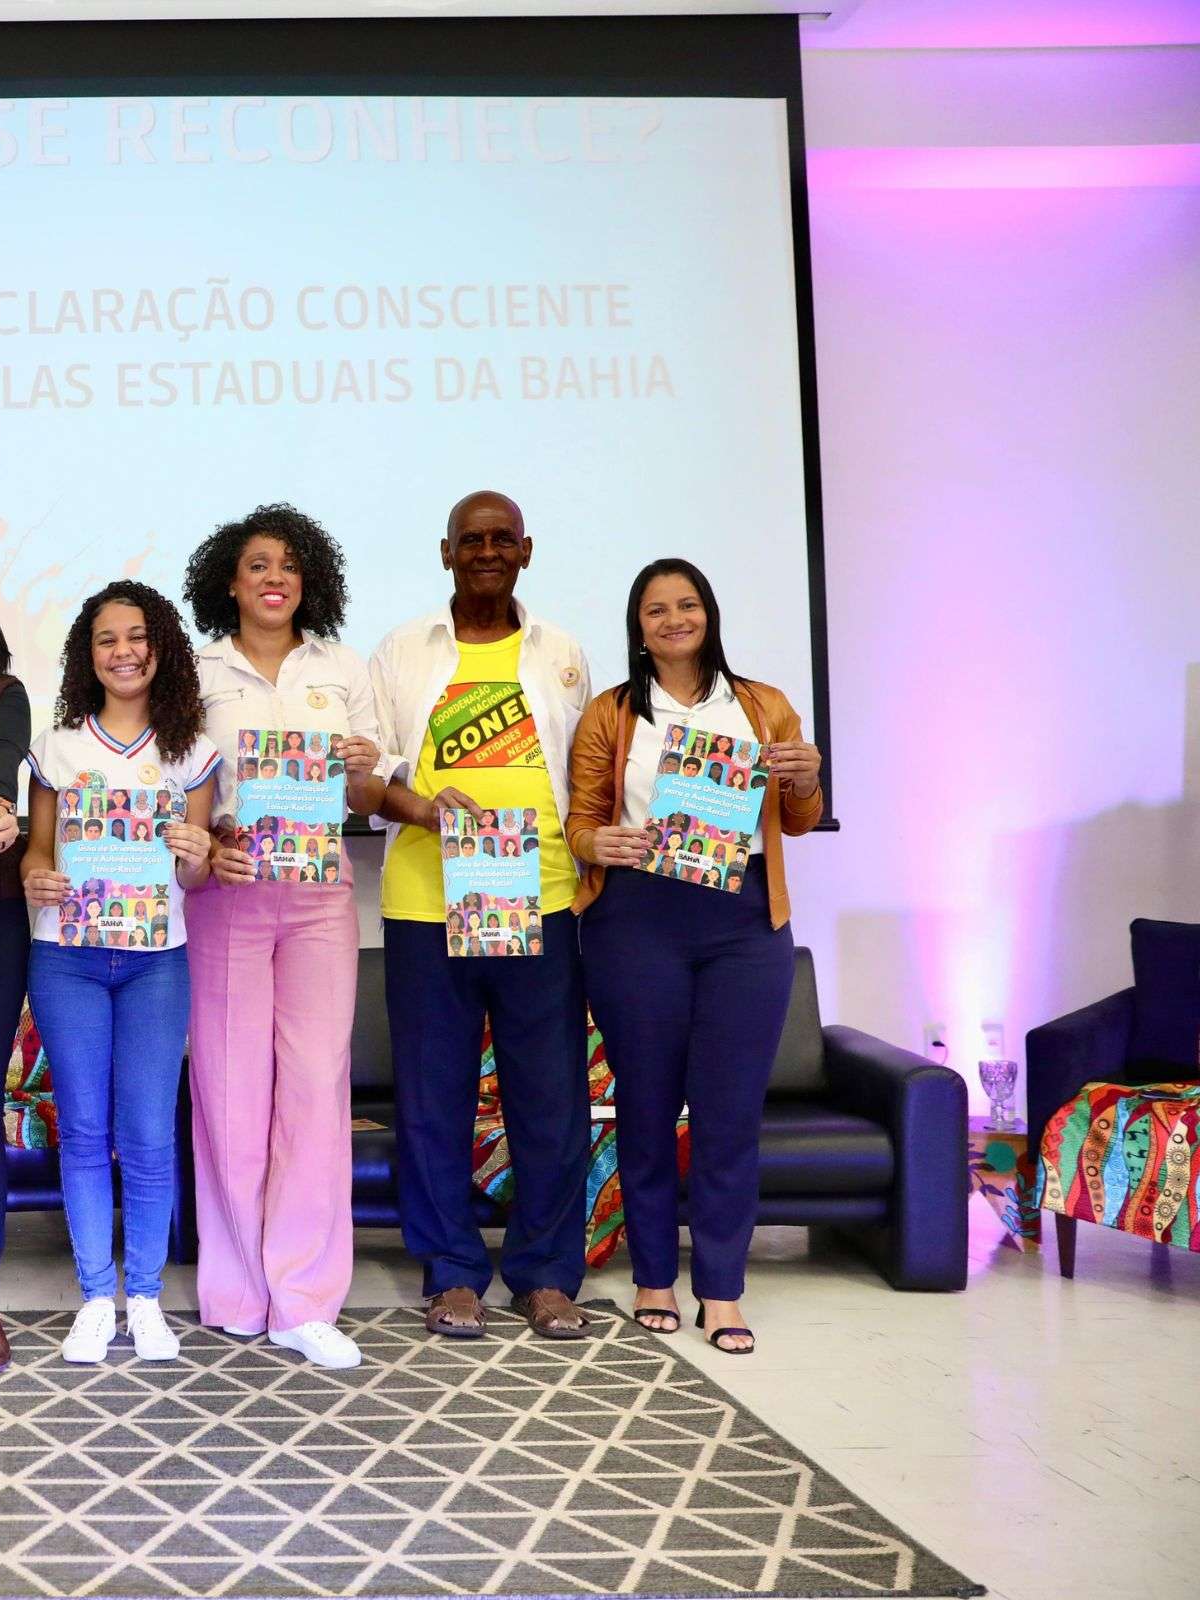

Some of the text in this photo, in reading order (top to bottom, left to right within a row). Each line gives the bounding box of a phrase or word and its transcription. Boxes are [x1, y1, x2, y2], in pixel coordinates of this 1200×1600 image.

[105, 97, 666, 165] RECONHECE?
[296, 283, 634, 332] CONSCIENTE
[116, 357, 414, 407] ESTADUAIS
[434, 356, 502, 402] DA
[519, 353, 678, 400] BAHIA
[433, 684, 491, 727] COORDENAÇÃO
[474, 728, 521, 763] ENTIDADES
